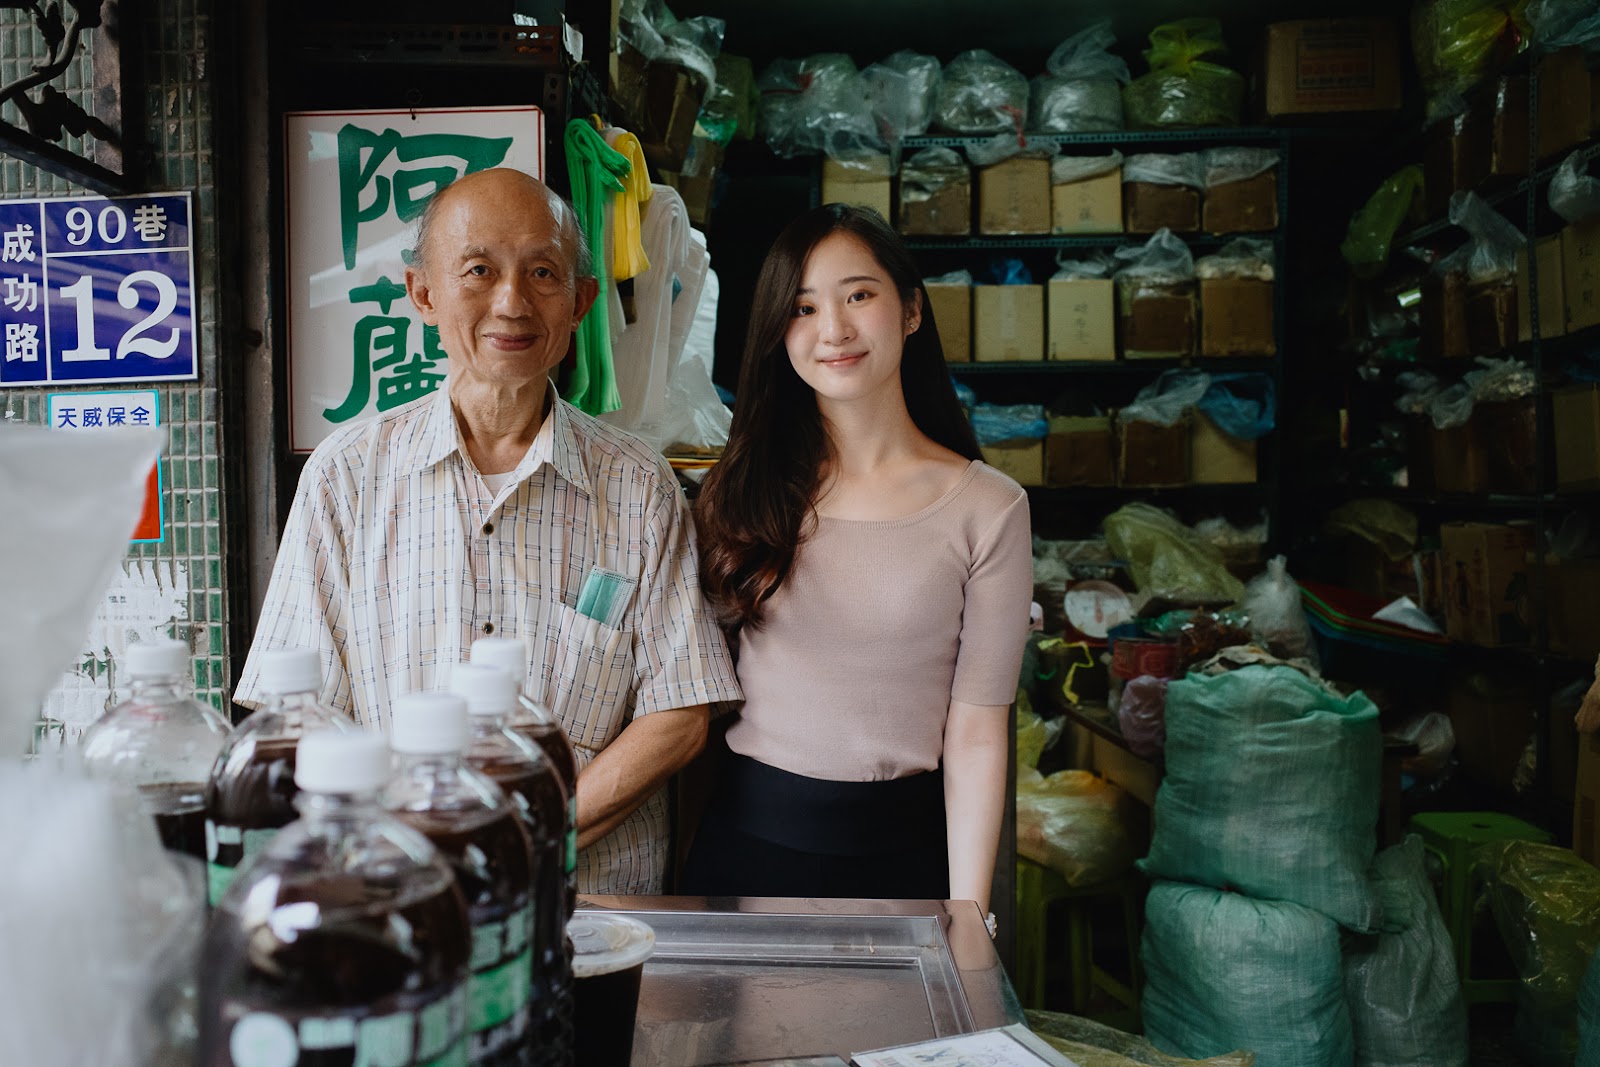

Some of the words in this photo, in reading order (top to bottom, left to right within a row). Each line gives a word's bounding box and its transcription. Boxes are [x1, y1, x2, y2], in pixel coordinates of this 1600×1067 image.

[65, 204, 168, 246] 90巷
[2, 223, 40, 363] 成功路
[59, 270, 181, 362] 12
[57, 406, 150, 429] 天威保全
